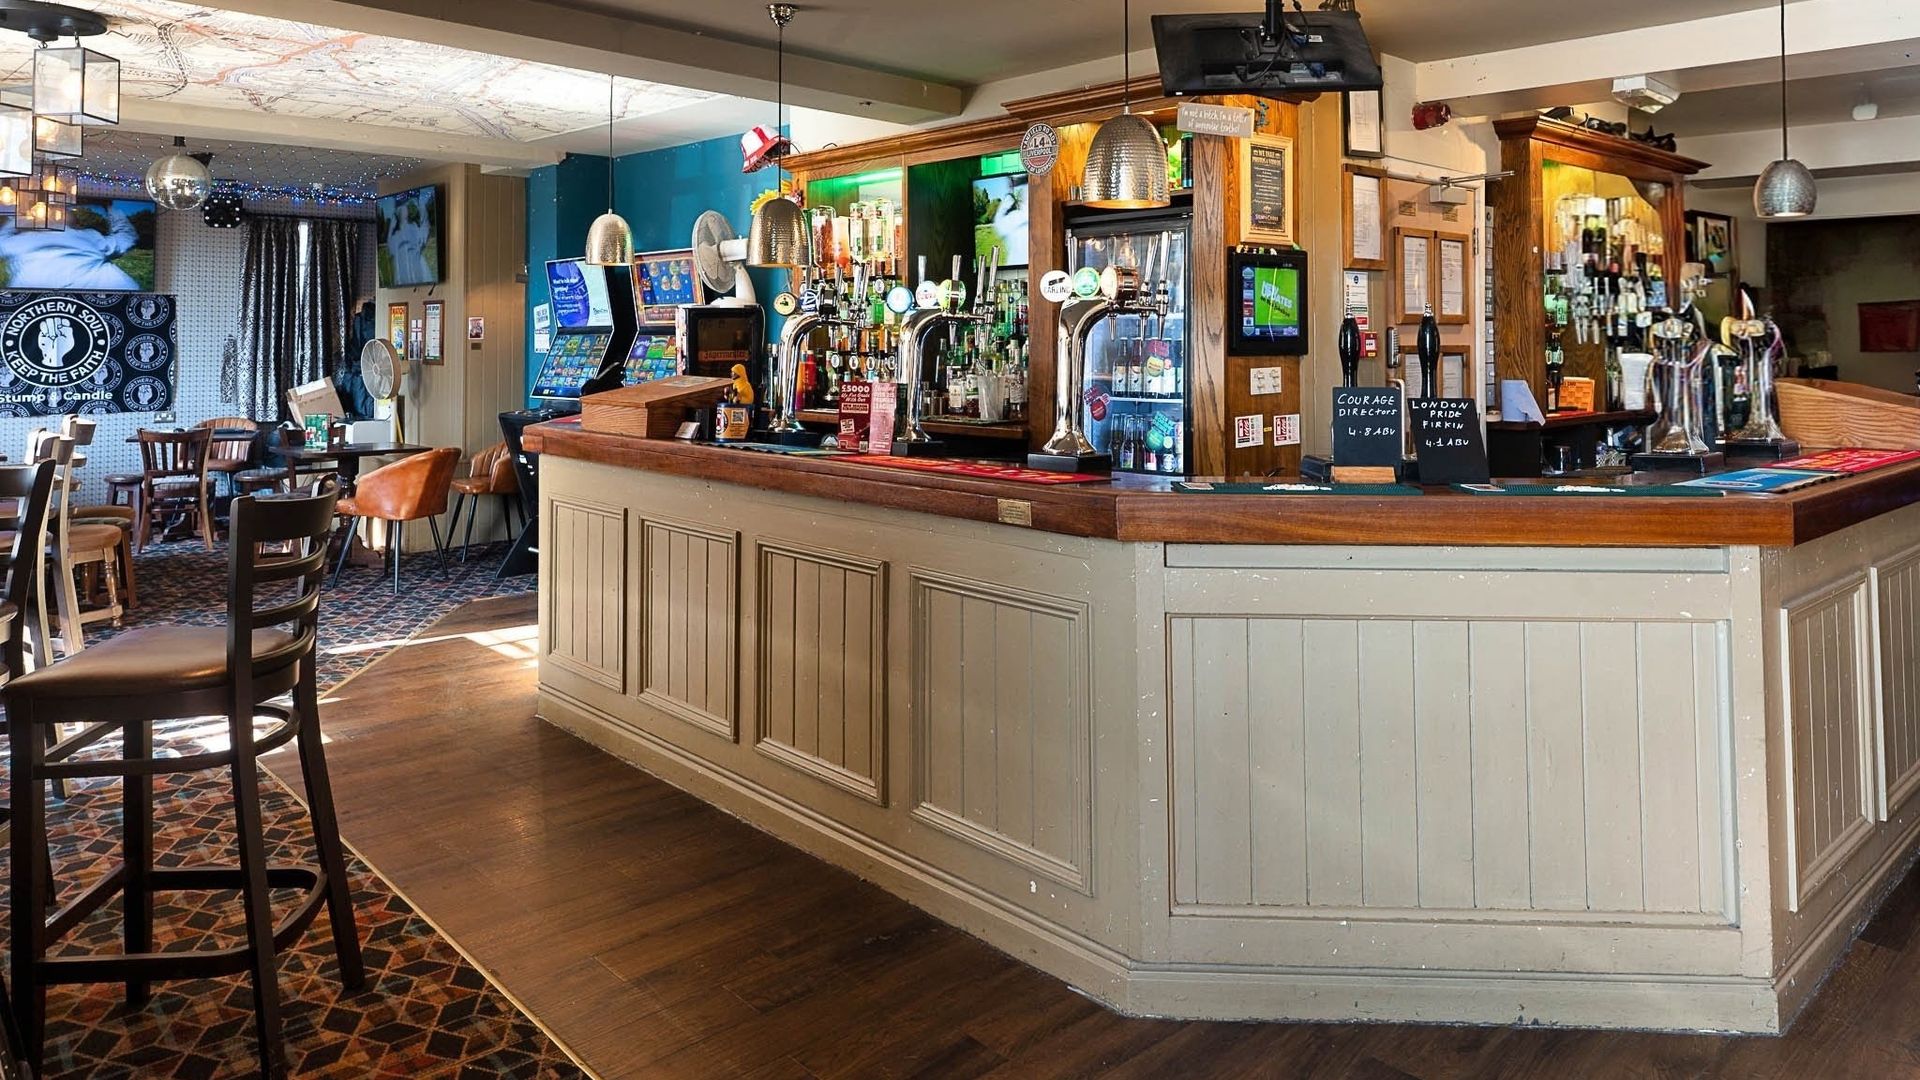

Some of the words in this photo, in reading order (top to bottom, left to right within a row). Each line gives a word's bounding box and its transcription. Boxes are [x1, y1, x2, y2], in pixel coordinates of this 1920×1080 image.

[1034, 137, 1045, 148] L4
[6, 301, 77, 336] NORTHERN
[78, 309, 103, 337] SOUL
[6, 350, 39, 378] KEEP
[40, 373, 68, 383] THE
[69, 350, 104, 379] FAITH
[841, 384, 870, 393] £5000
[63, 390, 114, 401] Candle
[1337, 393, 1395, 405] COURAGE
[1411, 400, 1469, 409] LONDON
[1430, 410, 1462, 418] PRIDE
[1422, 420, 1464, 429] FIRKIN
[1446, 438, 1469, 446] ABV
